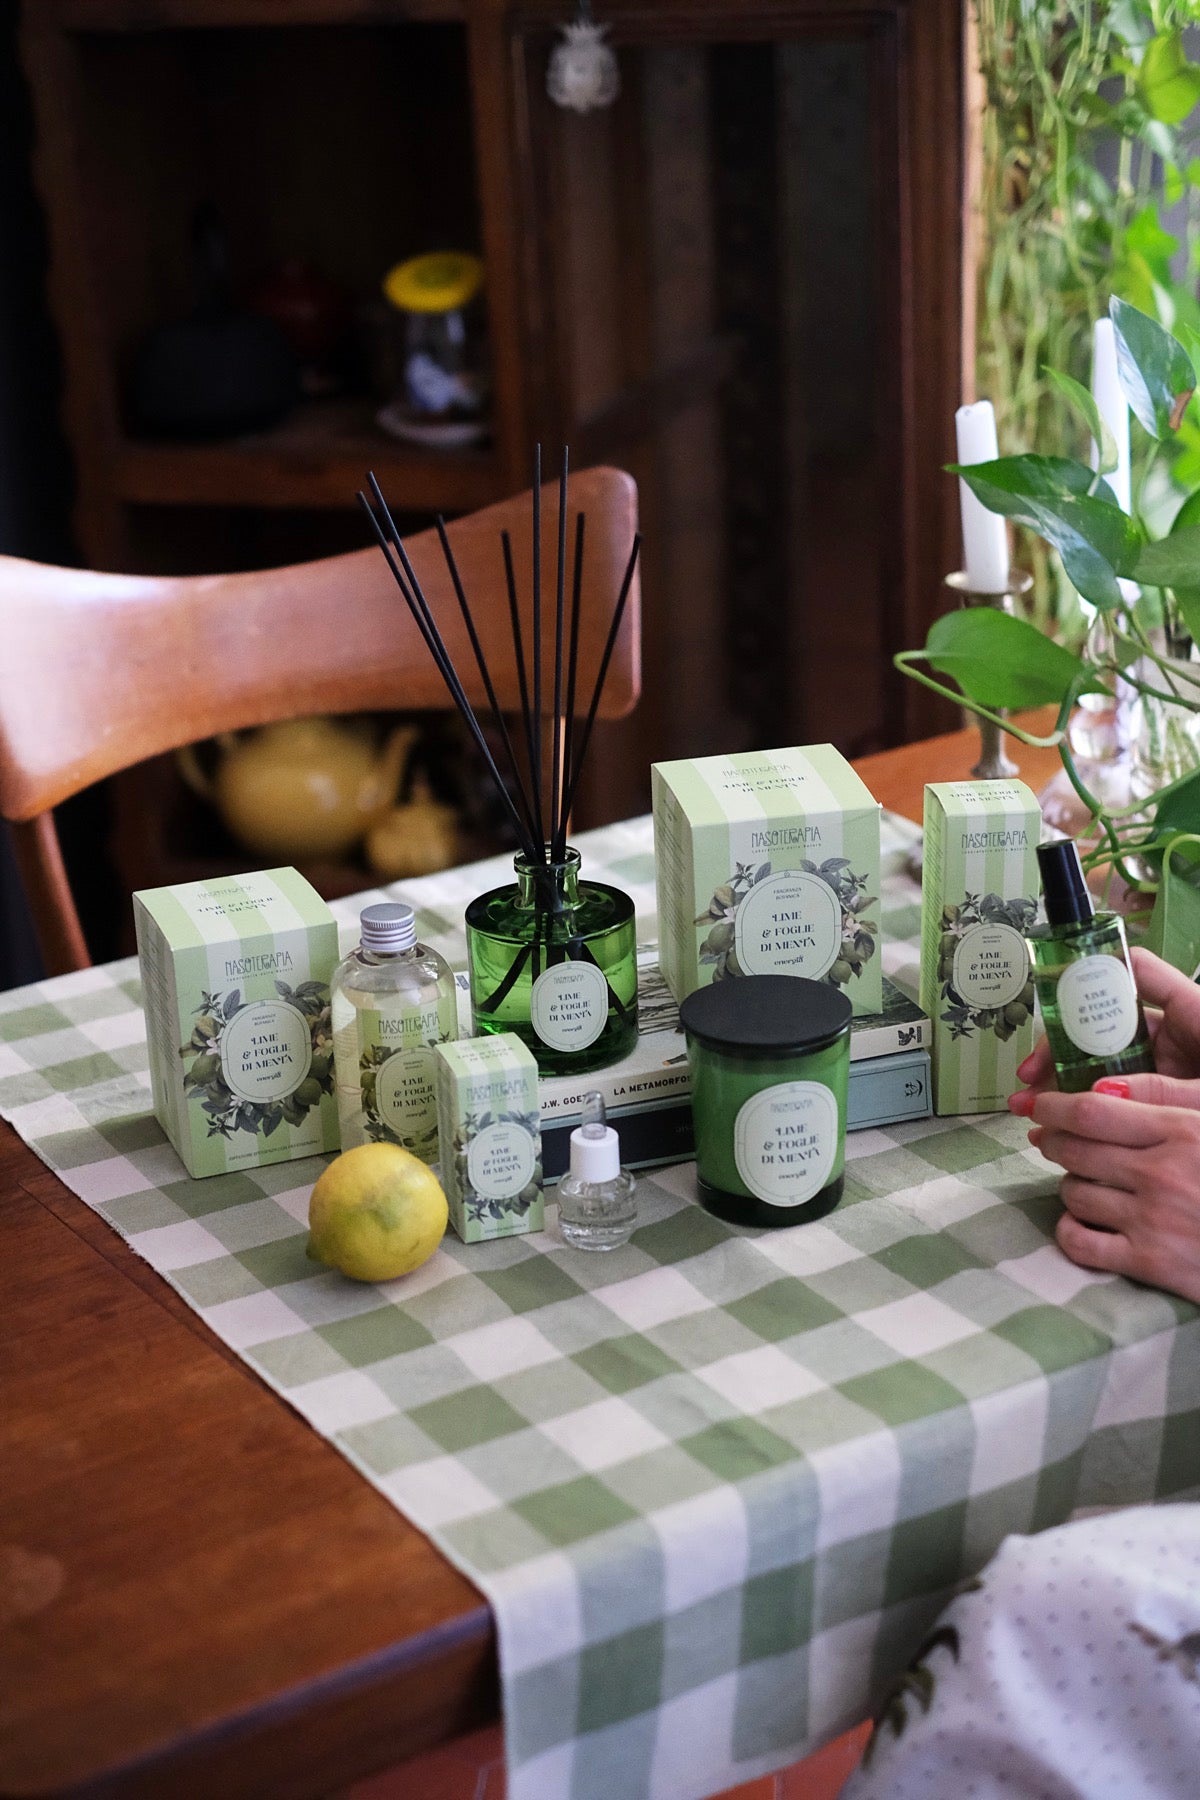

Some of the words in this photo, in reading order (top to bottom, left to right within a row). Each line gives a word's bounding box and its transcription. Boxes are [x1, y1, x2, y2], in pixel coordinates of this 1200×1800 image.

[751, 826, 822, 848] NASOTERAPIA
[961, 830, 1029, 849] NASOTERAPIA
[772, 911, 803, 923] LIME
[775, 924, 815, 938] FOGLIE
[760, 943, 773, 953] DI
[774, 936, 816, 952] MENTA
[225, 950, 293, 977] NASOTERAPIA
[251, 1032, 279, 1046] LIME
[253, 1042, 292, 1057] FOGLIE
[241, 1062, 253, 1072] DI
[255, 1053, 294, 1070] MENTA
[613, 1086, 627, 1097] LA
[541, 1099, 560, 1110] J.W.
